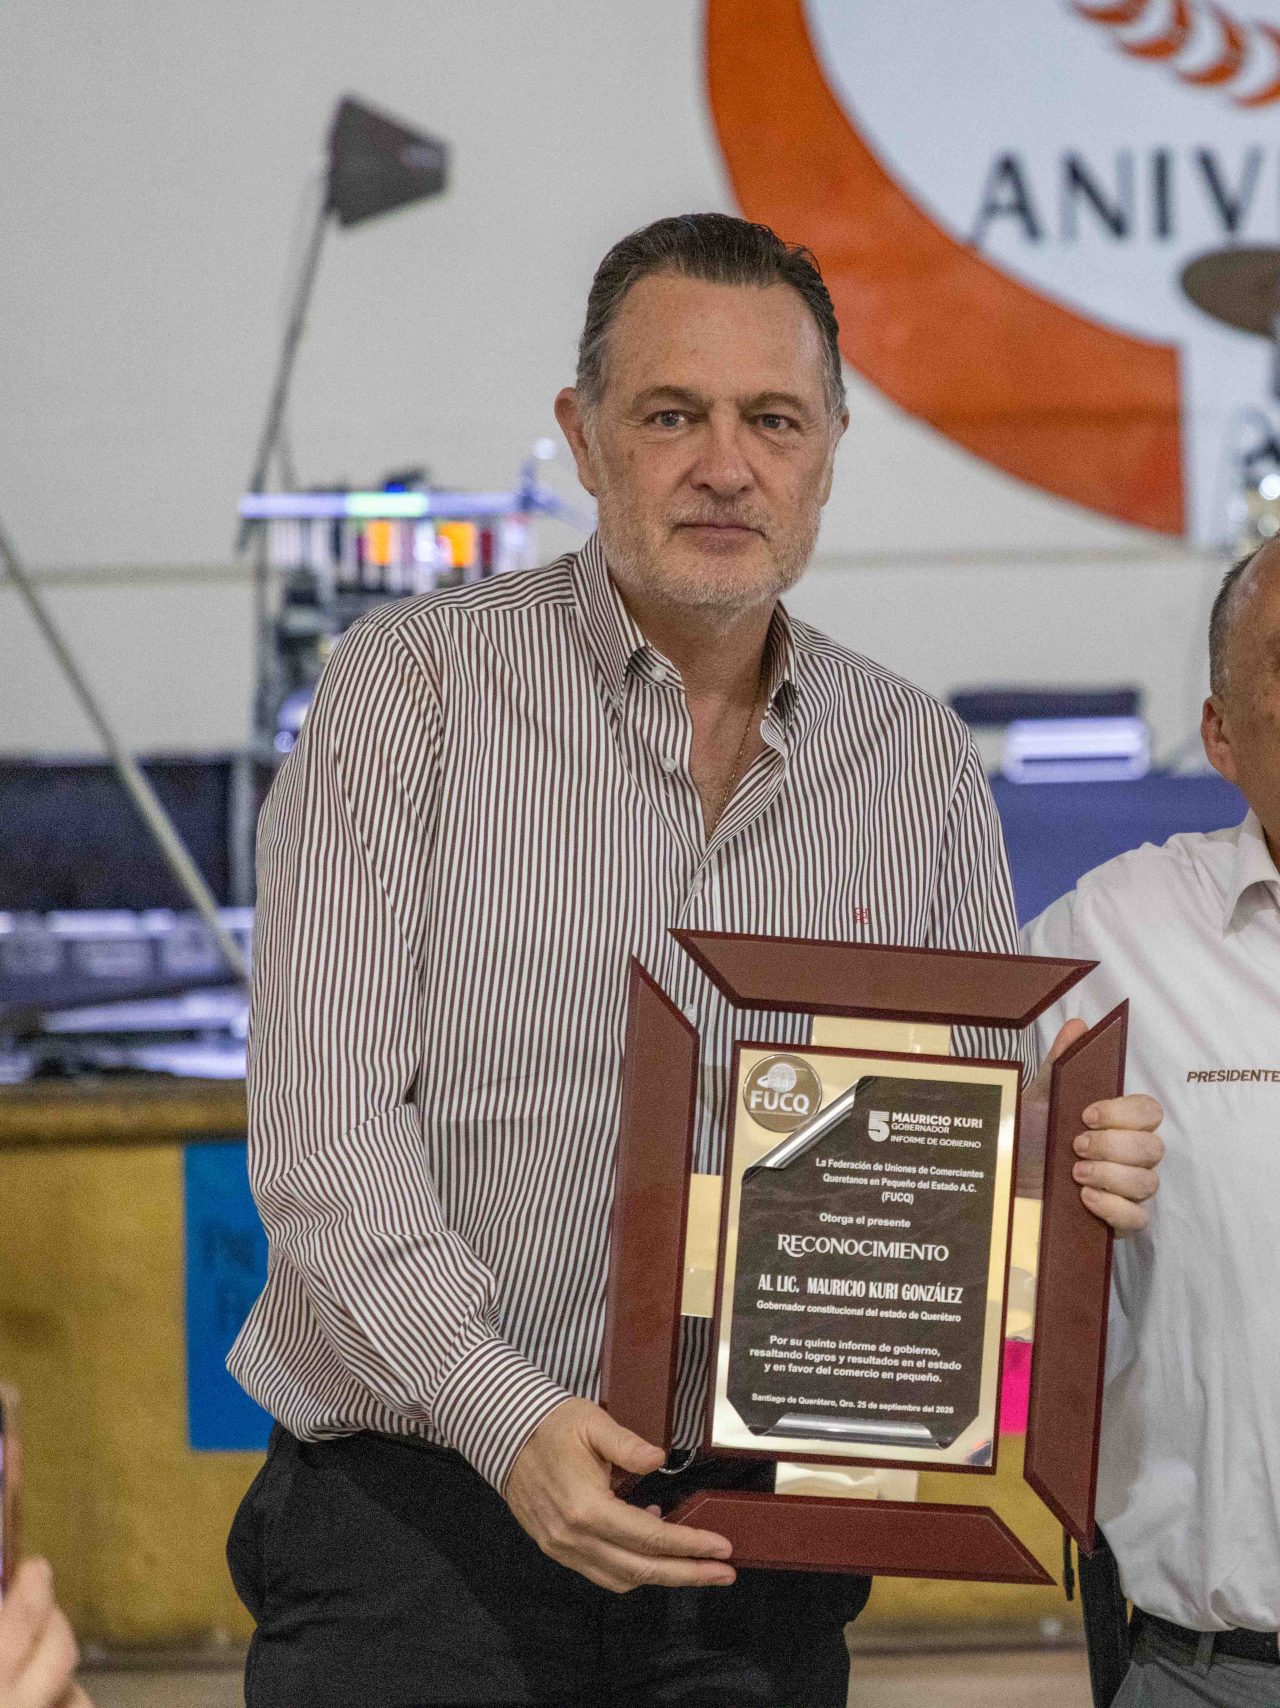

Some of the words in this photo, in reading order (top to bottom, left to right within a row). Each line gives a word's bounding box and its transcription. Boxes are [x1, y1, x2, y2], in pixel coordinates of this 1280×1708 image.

[1187, 1070, 1280, 1082] PRESIDENTE
[750, 1091, 809, 1115] FUCQ
[868, 1110, 890, 1142] 5
[891, 1123, 949, 1133] GOBERNADOR
[892, 1112, 951, 1126] MAURICIO
[954, 1117, 982, 1128] KURI
[890, 1135, 925, 1144] INFORME
[927, 1137, 938, 1145] DE
[939, 1138, 981, 1148] GOBIERNO
[815, 1157, 826, 1167] La
[828, 1158, 871, 1170] Federación
[872, 1162, 883, 1171] de
[884, 1163, 917, 1173] Uniones
[917, 1165, 928, 1174] de
[929, 1166, 984, 1178] Comerciantes
[881, 1177, 916, 1188] Pequeño
[917, 1180, 930, 1189] del
[931, 1180, 959, 1191] Estado
[959, 1183, 976, 1192] A.C.
[881, 1191, 914, 1205] (FUCQ)
[819, 1212, 853, 1225] Otorga
[855, 1215, 865, 1224] el
[867, 1218, 910, 1227] presente
[777, 1234, 949, 1261] RECONOCIMIENTO
[757, 1273, 773, 1291] AL
[776, 1275, 799, 1293] LIC.
[807, 1277, 866, 1297] MAURICIO
[868, 1281, 898, 1299] KURI
[901, 1282, 963, 1303] GONZÁLEZ
[756, 1300, 806, 1312] Gobernador
[806, 1305, 864, 1315] constitucional
[865, 1308, 878, 1316] del
[879, 1309, 907, 1318] estado
[908, 1311, 919, 1319] de
[920, 1311, 961, 1322] Querétaro
[769, 1335, 788, 1345] Por
[789, 1338, 802, 1346] su
[804, 1338, 836, 1348] quinto
[838, 1340, 876, 1351] informe
[878, 1343, 891, 1352] de
[893, 1344, 940, 1357] gobierno,
[749, 1348, 803, 1359] resaltando
[804, 1351, 836, 1363] logros
[838, 1355, 845, 1364] y
[847, 1355, 899, 1366] resultados
[901, 1359, 914, 1367] en
[916, 1359, 925, 1367] el
[927, 1360, 961, 1370] estado
[764, 1363, 772, 1373] y
[773, 1364, 786, 1372] en
[788, 1363, 814, 1373] favor
[815, 1365, 831, 1375] del
[833, 1368, 879, 1378] comercio
[881, 1371, 894, 1379] en
[896, 1372, 942, 1382] pequeño.
